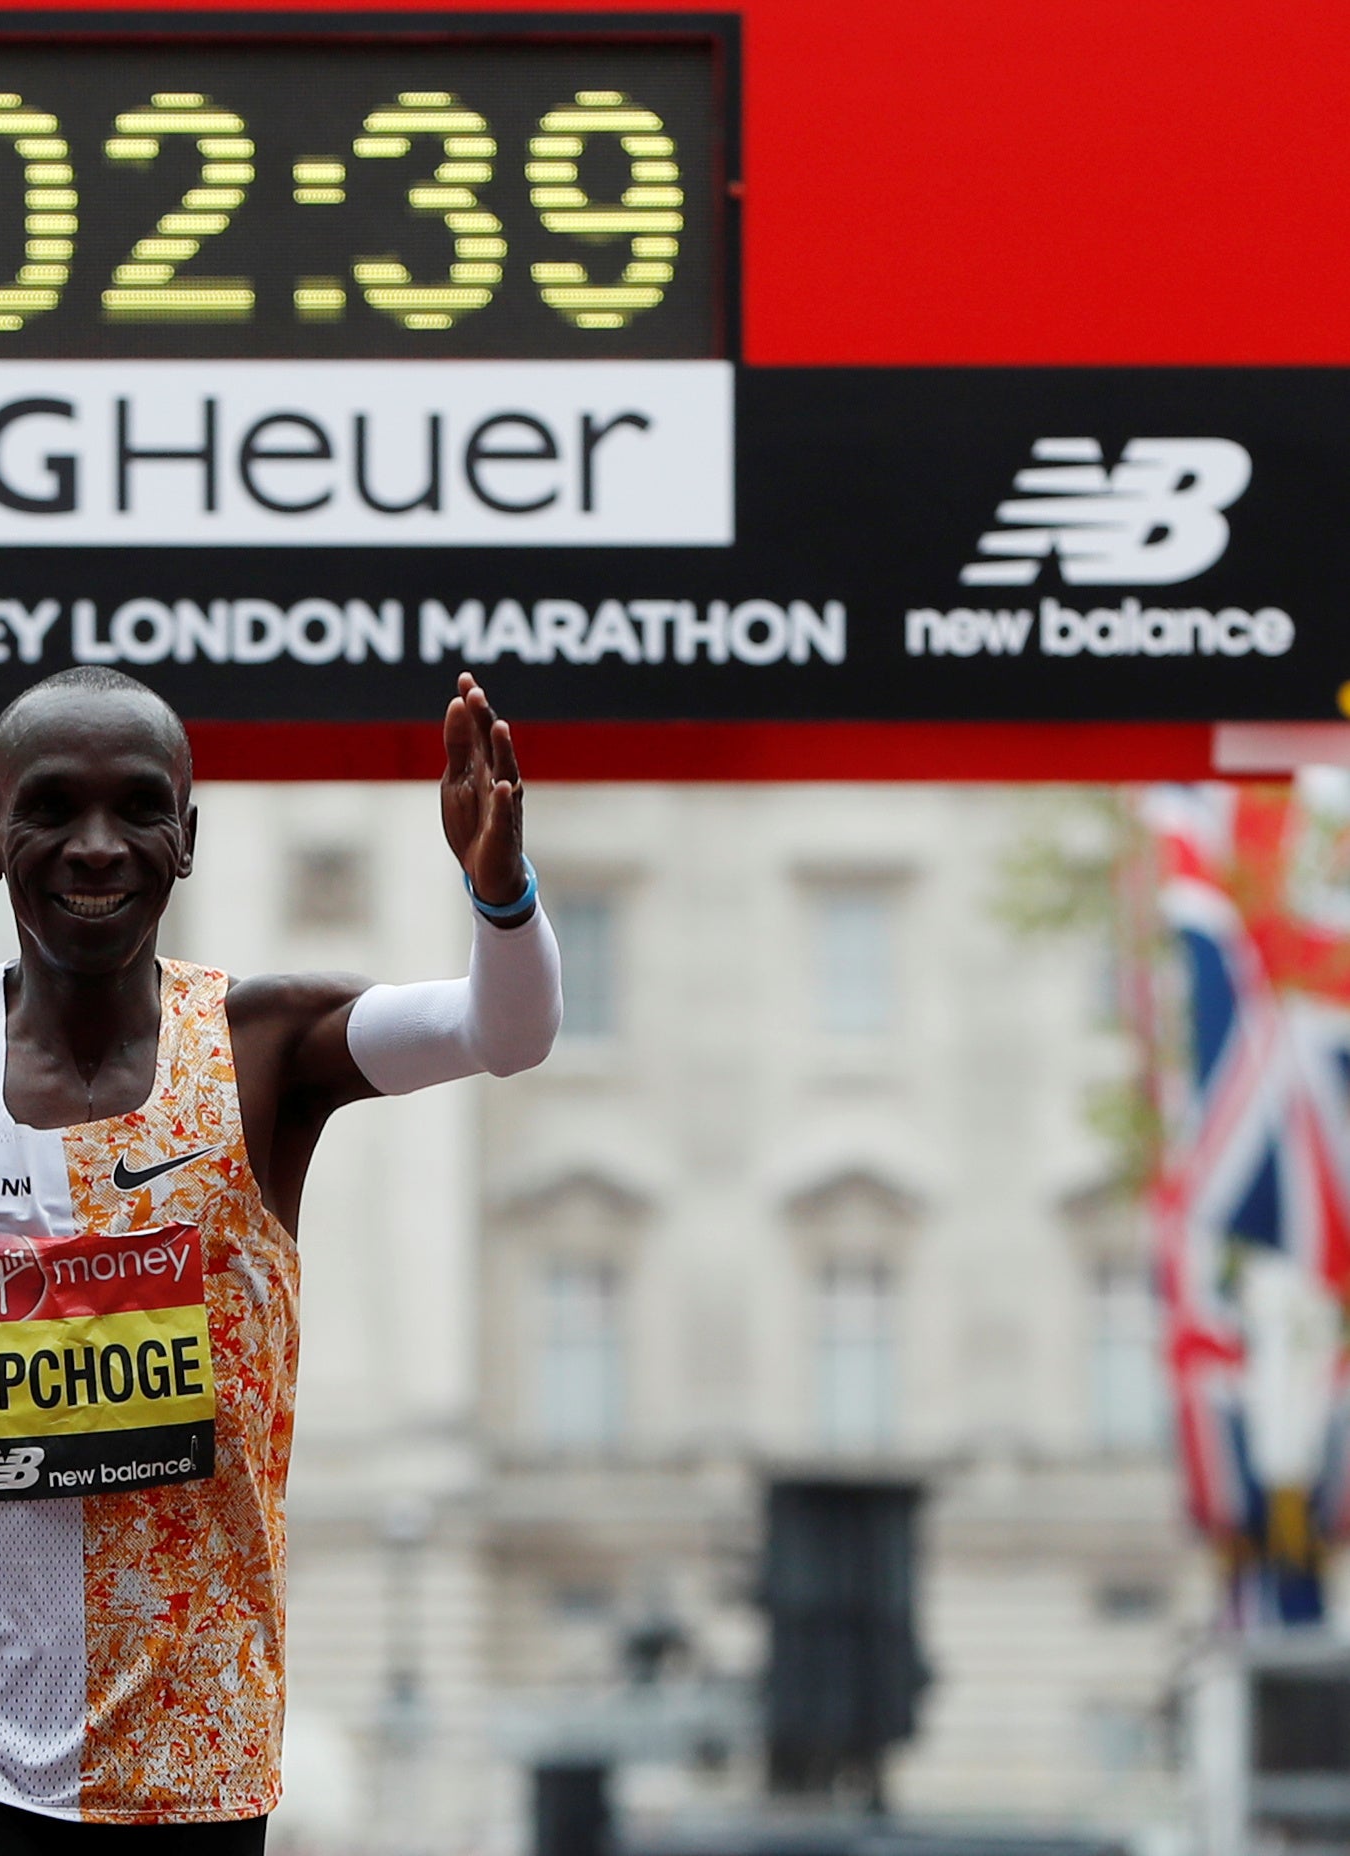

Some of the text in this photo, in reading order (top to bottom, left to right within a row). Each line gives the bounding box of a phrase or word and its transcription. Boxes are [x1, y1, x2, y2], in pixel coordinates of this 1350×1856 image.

[71, 598, 404, 665] LONDON
[419, 598, 847, 665] MARATHON
[905, 597, 1296, 658] new balance
[52, 1243, 191, 1285] money
[49, 1457, 193, 1488] new balance
